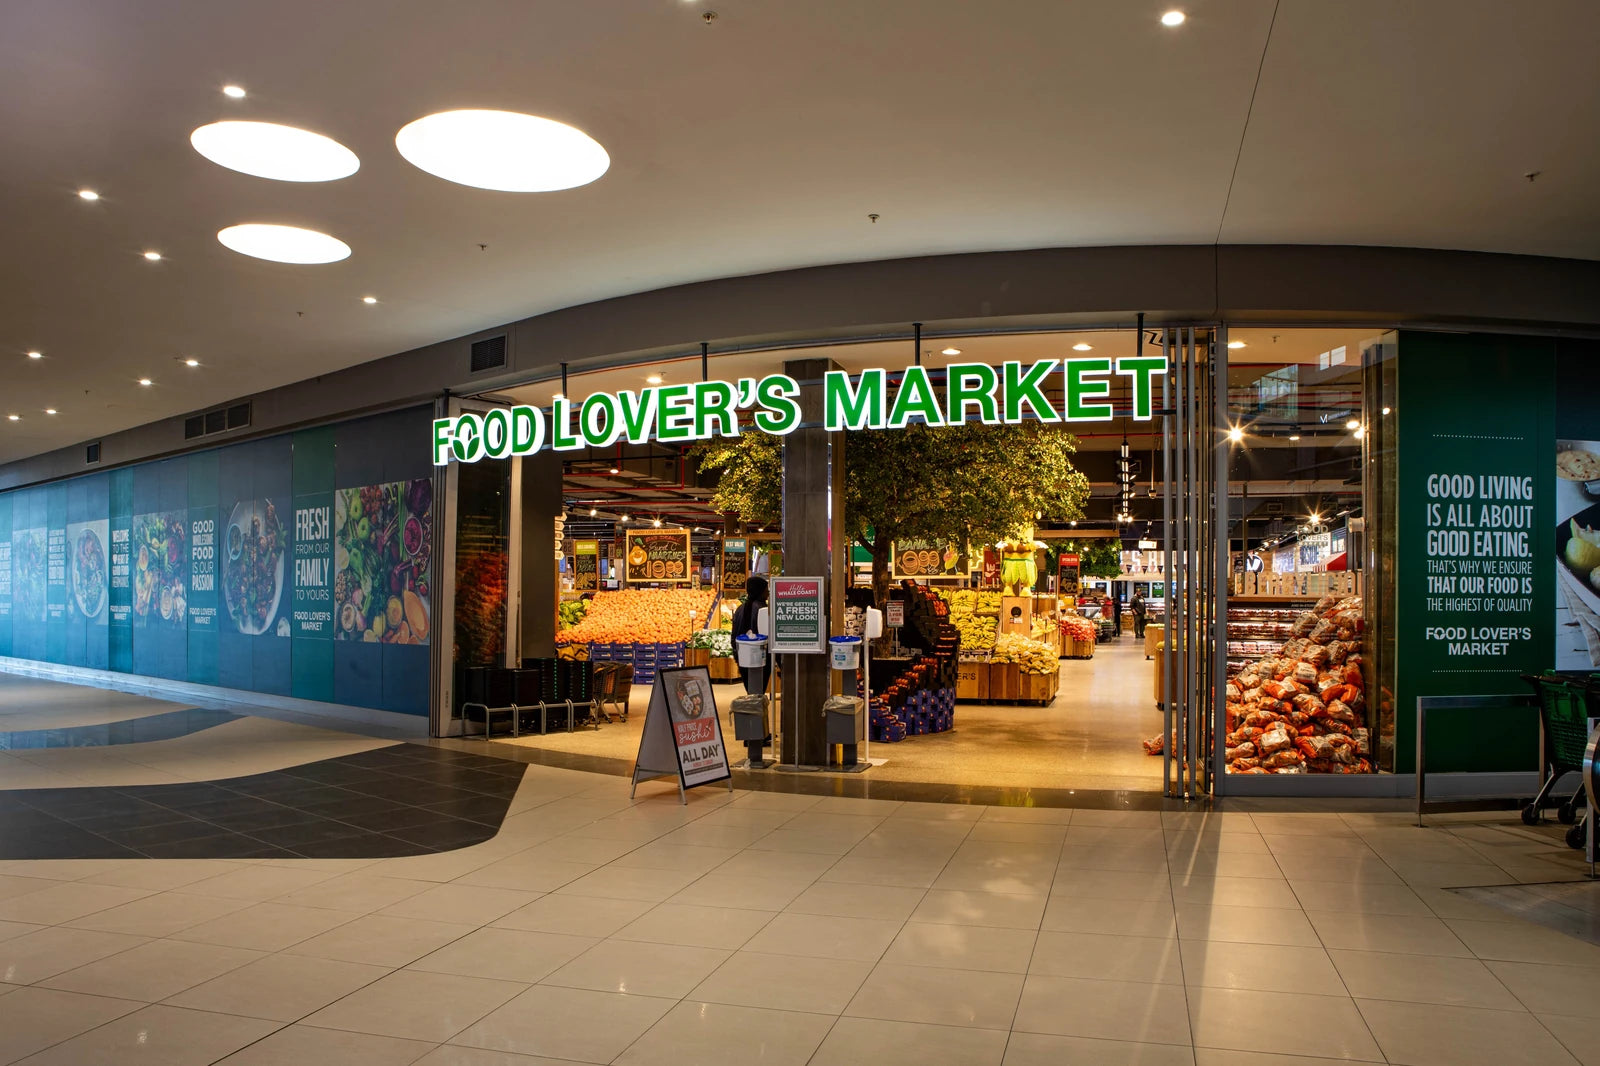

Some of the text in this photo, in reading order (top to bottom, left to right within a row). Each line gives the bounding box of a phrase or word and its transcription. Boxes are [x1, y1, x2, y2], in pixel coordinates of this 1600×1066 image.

[433, 356, 1168, 465] FOOD LOVER'S MARKET
[1427, 474, 1533, 500] GOOD LIVING
[1427, 503, 1533, 528] IS ALL ABOUT
[192, 520, 214, 534] GOOD
[296, 507, 329, 541] FRESH
[120, 543, 129, 553] THE
[296, 543, 329, 554] FROM OUR
[1427, 530, 1532, 558] GOOD EATING.
[192, 546, 214, 560] FOOD
[192, 561, 213, 573] IS OUR
[296, 558, 329, 586] FAMILY
[1427, 560, 1532, 575] THAT'S WHY WE ENSURE
[192, 575, 214, 591] PASSION
[1427, 576, 1532, 594] THAT OUR FOOD IS
[296, 589, 329, 600] TO YOURS
[776, 606, 818, 614] A FRESH
[1427, 598, 1533, 612] THE HIGHEST OF QUALITY
[195, 616, 211, 624] MARKET
[294, 611, 331, 621] FOOD LOVER'S
[302, 622, 323, 631] MARKET
[1426, 627, 1532, 640] FOOD LOVER'S
[1448, 642, 1509, 656] MARKET
[957, 672, 976, 680] ER'S
[683, 749, 700, 764] ALL
[701, 745, 719, 759] DAY
